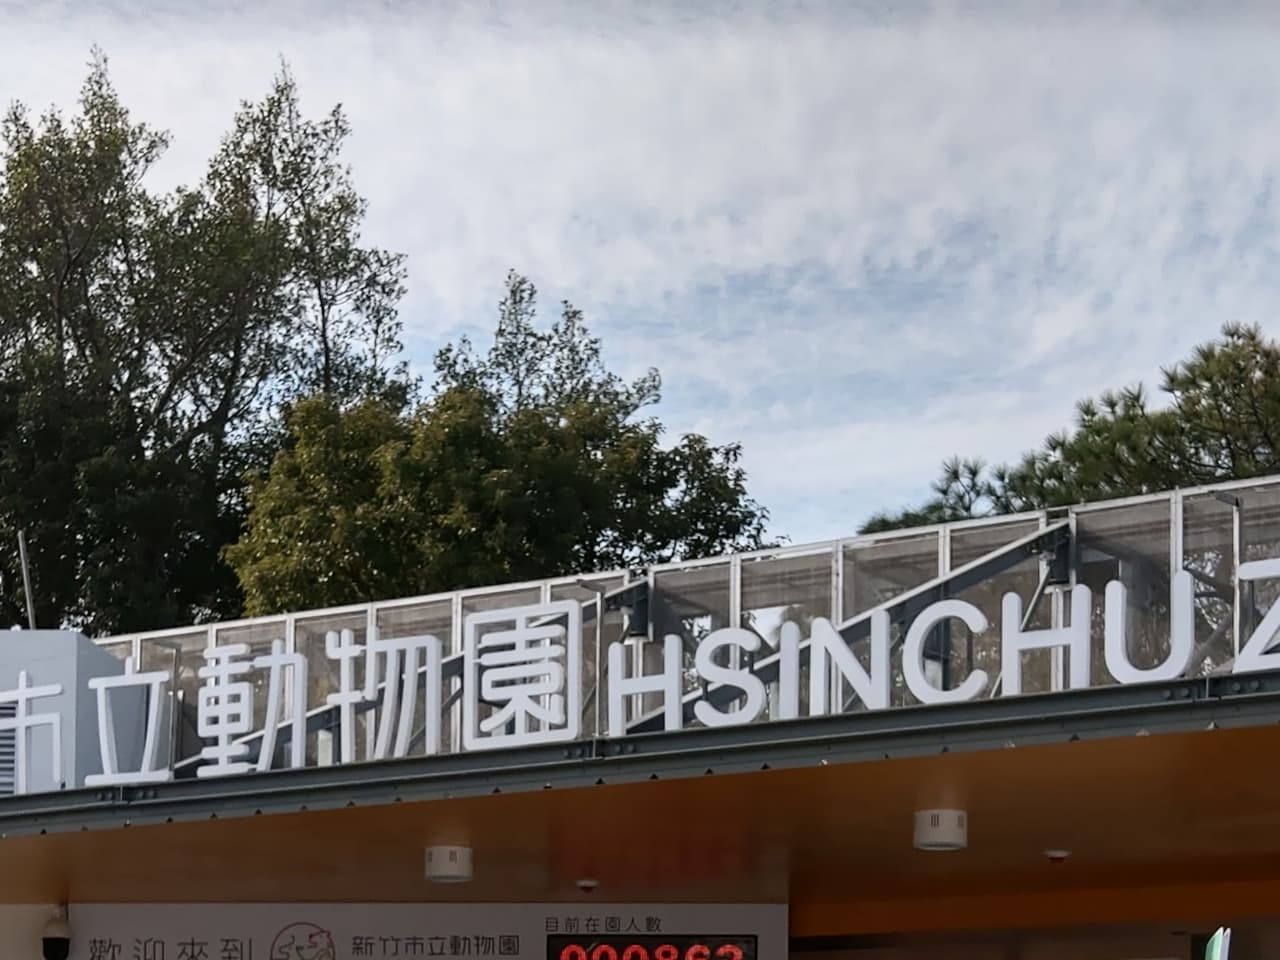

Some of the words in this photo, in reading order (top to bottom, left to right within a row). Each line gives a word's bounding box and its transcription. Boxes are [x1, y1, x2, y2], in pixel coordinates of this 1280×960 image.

[608, 568, 1195, 737] HSINCHU
[351, 934, 520, 957] 新竹市立動物園
